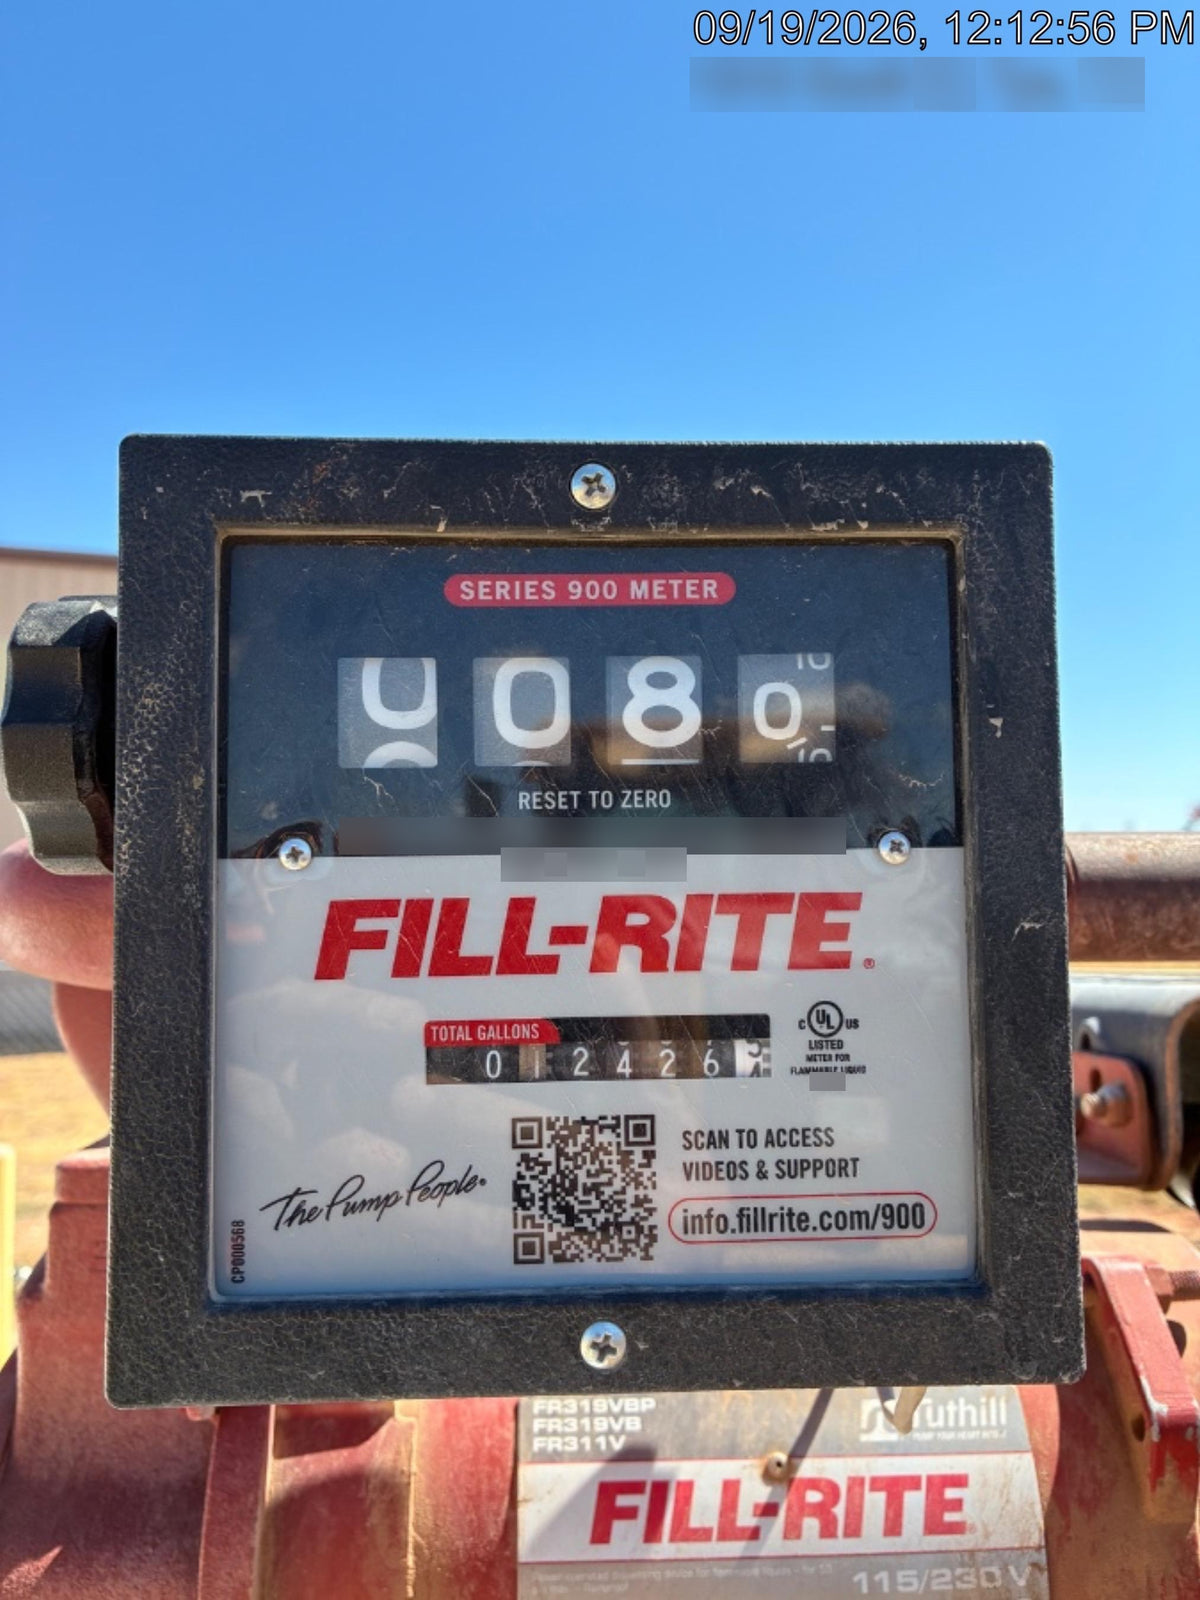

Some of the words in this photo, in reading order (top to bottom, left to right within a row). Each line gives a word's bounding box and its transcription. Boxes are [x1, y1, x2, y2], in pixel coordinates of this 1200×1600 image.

[460, 580, 556, 600] SERIES
[568, 580, 618, 599] 900
[630, 579, 719, 599] METER
[518, 790, 581, 810] RESET
[588, 790, 614, 809] TO
[621, 788, 671, 808] ZERO
[314, 892, 863, 980] FILL-RITE
[430, 1025, 473, 1042] TOTAL
[477, 1023, 540, 1040] GALLONS
[846, 1018, 860, 1030] US
[808, 1039, 844, 1051] LISTED
[682, 1129, 730, 1151] SCAN
[736, 1128, 759, 1150] TO
[764, 1127, 835, 1149] ACCESS
[682, 1160, 749, 1182] VIDEOS
[755, 1160, 769, 1181] &
[775, 1157, 860, 1180] SUPPORT
[259, 1186, 323, 1231] The
[325, 1174, 405, 1222] Pump
[682, 1202, 926, 1236] info.fillrite.com/900
[532, 1434, 627, 1453] FR311V
[589, 1473, 969, 1546] FILL-RITE
[853, 1566, 1003, 1595] 115/230
[1008, 1564, 1032, 1587] V
